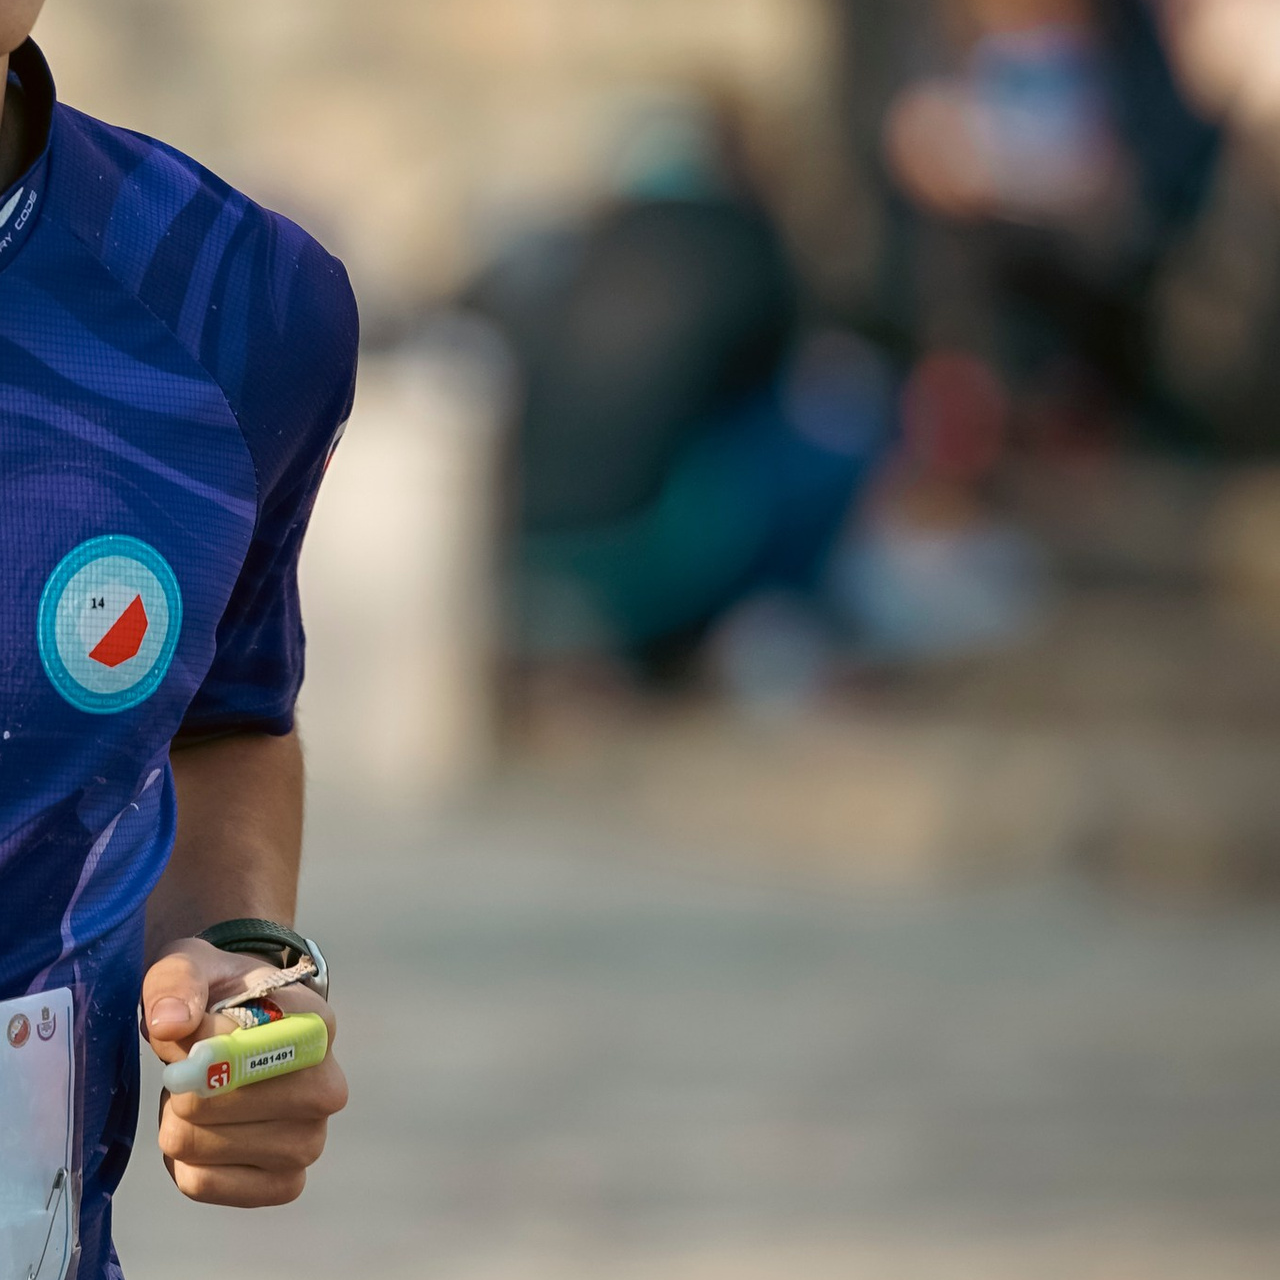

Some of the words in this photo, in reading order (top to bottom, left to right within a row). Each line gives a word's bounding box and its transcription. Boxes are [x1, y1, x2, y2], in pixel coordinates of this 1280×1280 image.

[14, 190, 37, 230] CODE
[91, 597, 105, 609] 14
[250, 1049, 293, 1069] 8481491
